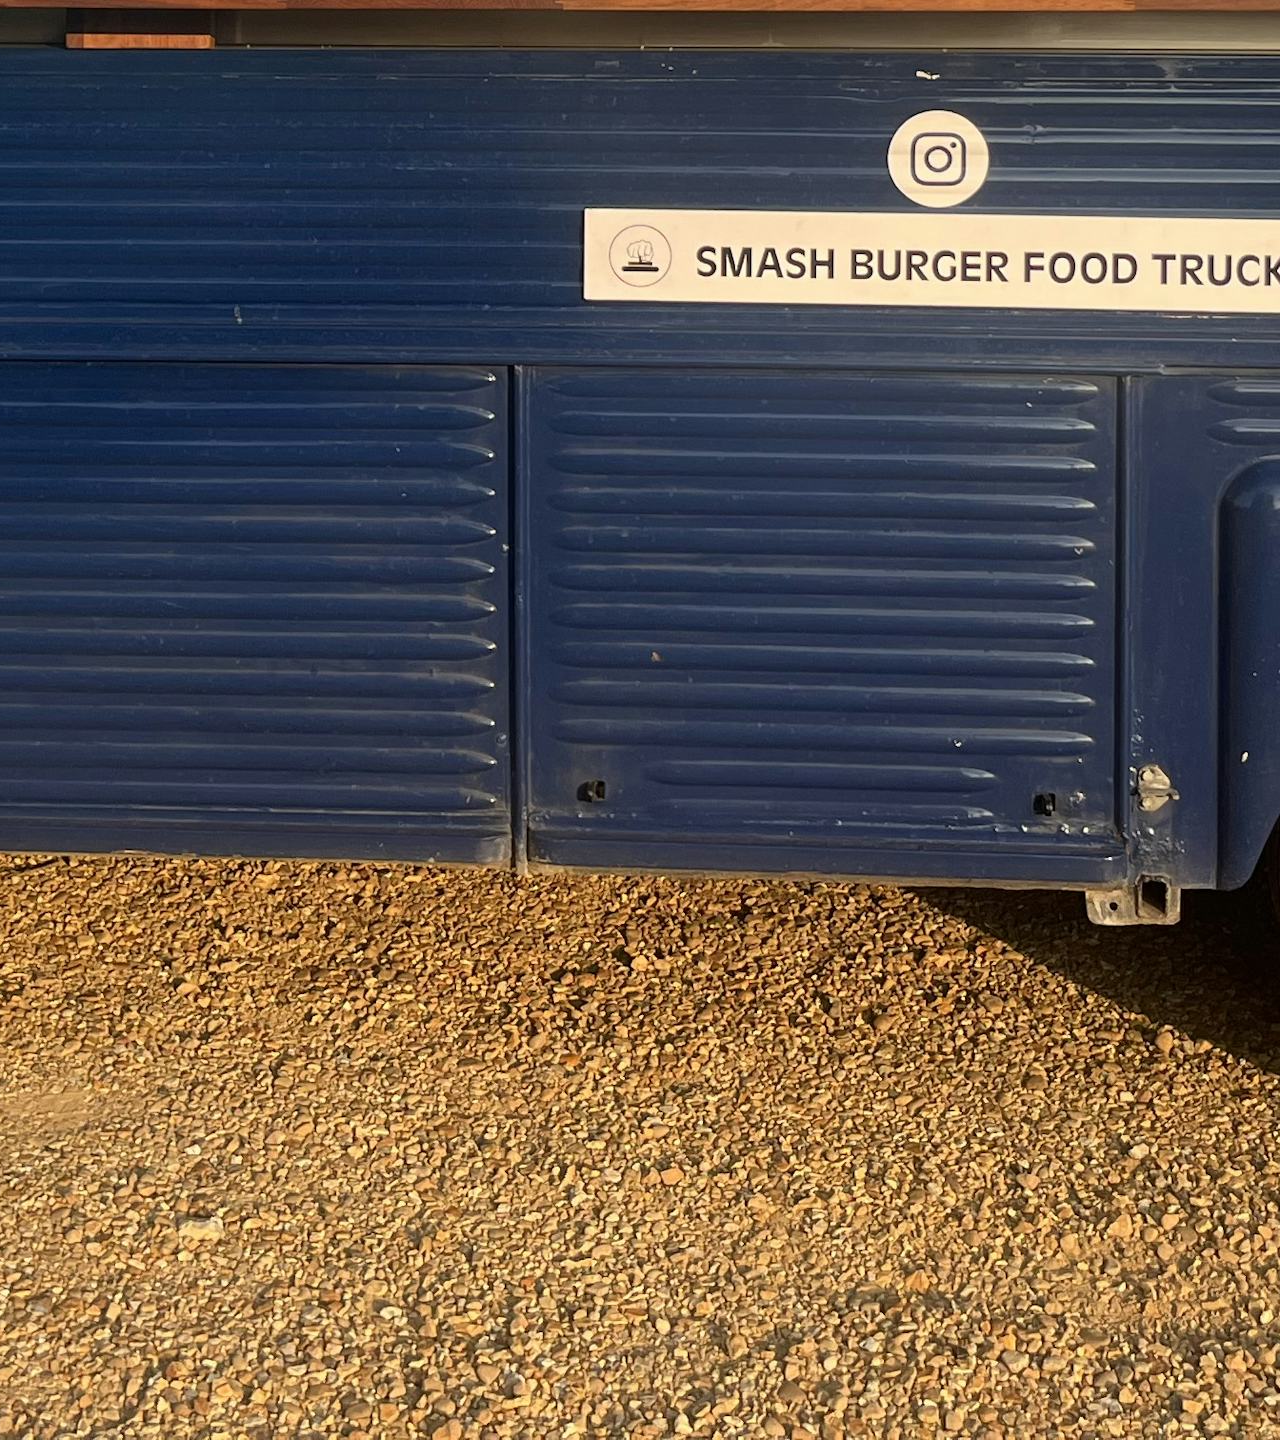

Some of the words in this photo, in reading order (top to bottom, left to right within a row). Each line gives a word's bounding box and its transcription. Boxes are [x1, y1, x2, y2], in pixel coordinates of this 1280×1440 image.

[696, 245, 835, 279] SMASH
[851, 248, 1009, 282] BURGER
[1024, 252, 1138, 284] FOOD
